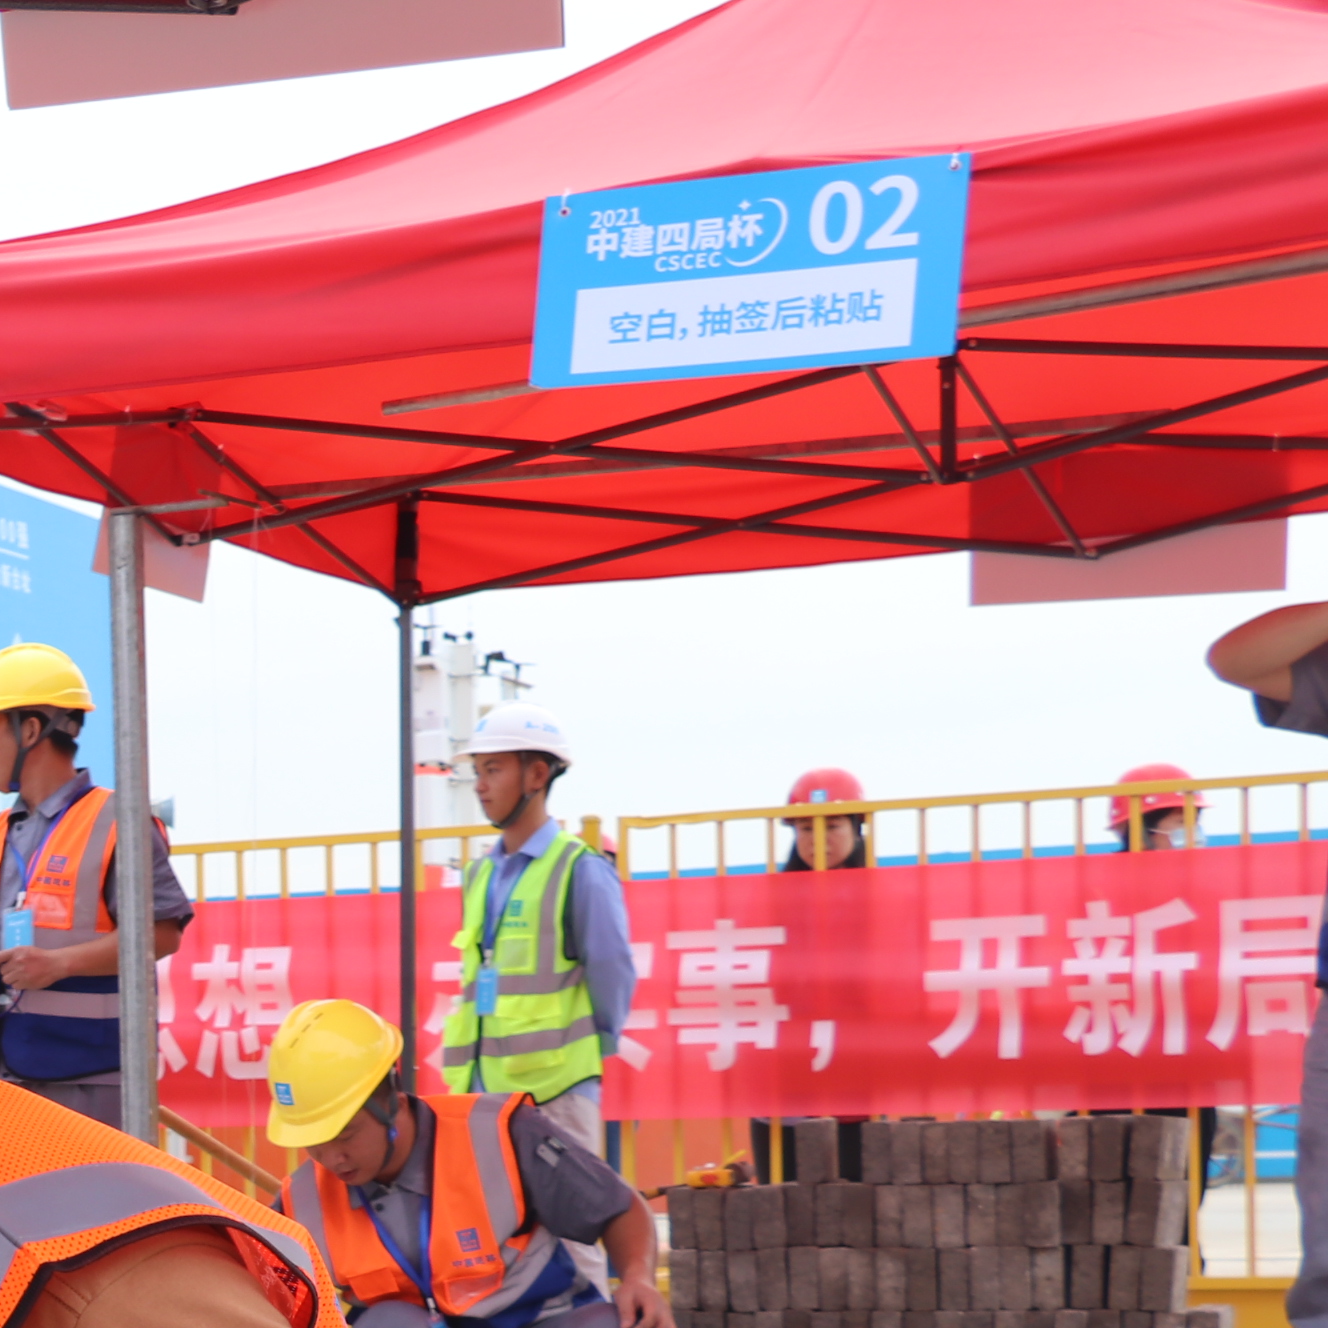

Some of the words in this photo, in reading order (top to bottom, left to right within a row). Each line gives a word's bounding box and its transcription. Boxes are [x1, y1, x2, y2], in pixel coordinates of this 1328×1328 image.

[589, 207, 640, 230] 2021
[809, 173, 920, 256] 02
[585, 212, 764, 261] 中建四局杯
[654, 250, 723, 273] CSCEC
